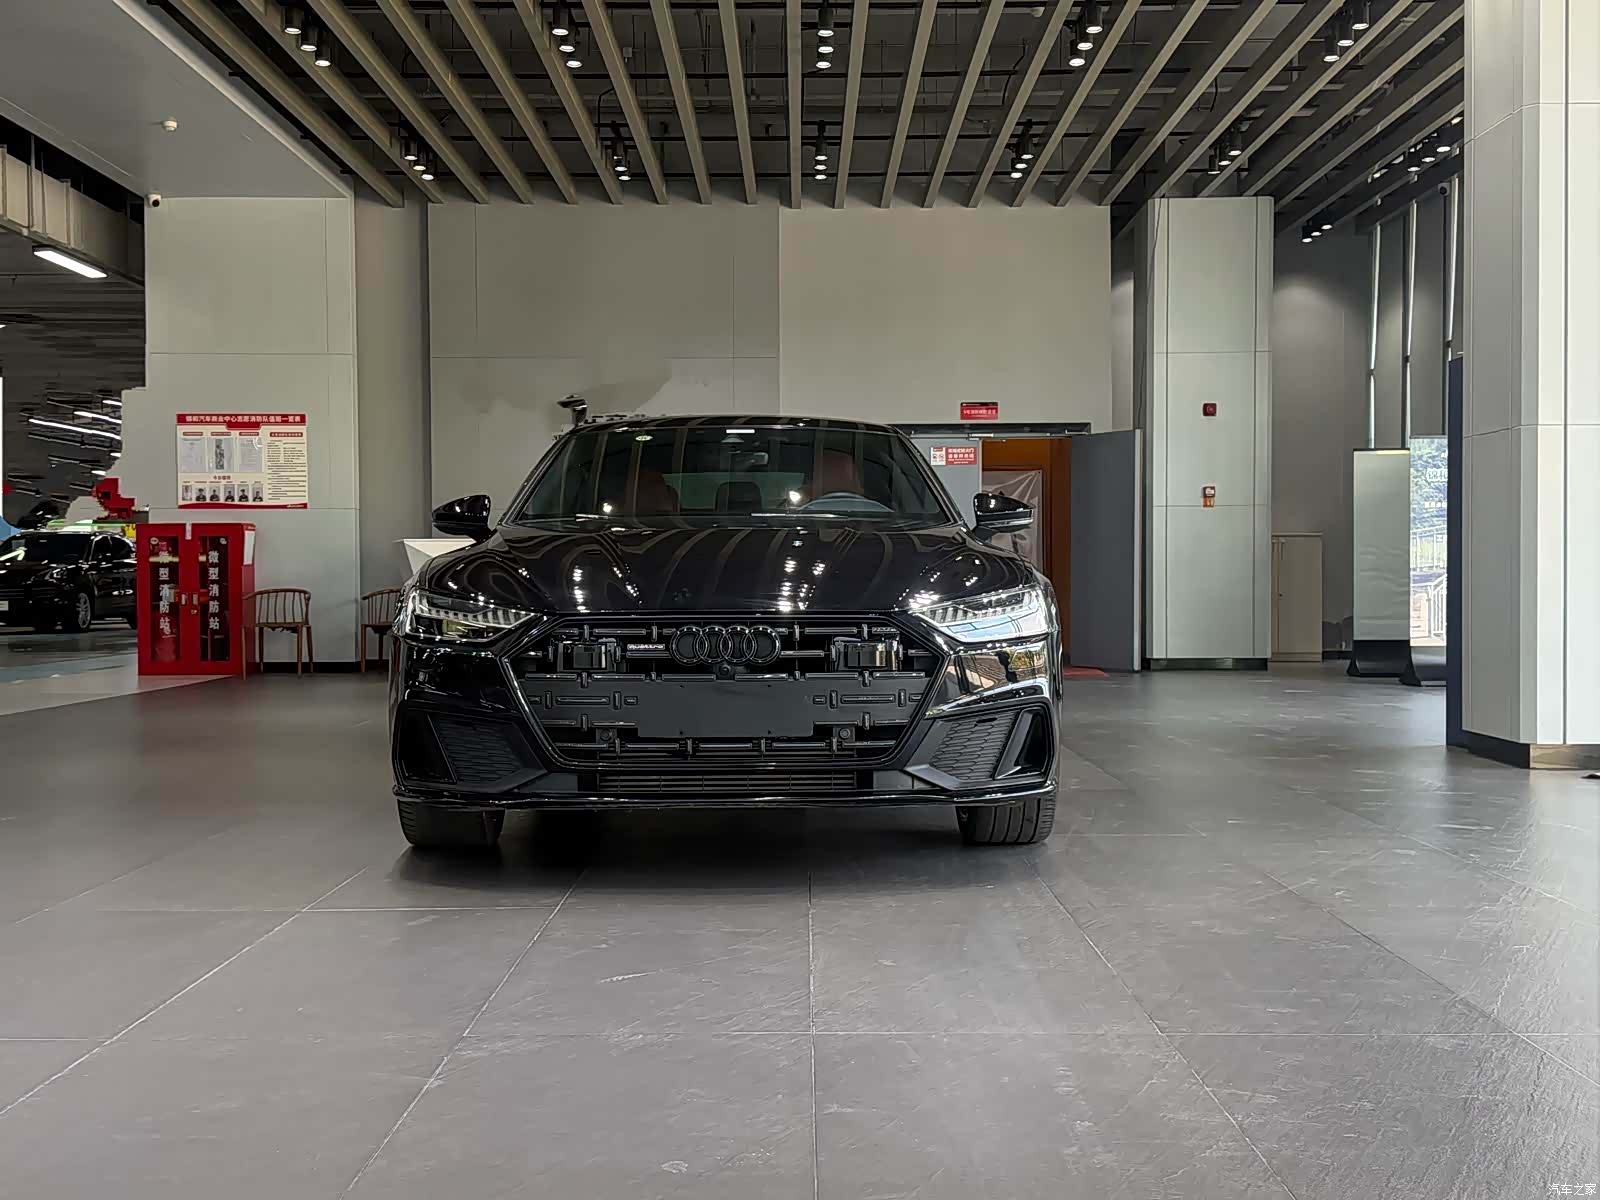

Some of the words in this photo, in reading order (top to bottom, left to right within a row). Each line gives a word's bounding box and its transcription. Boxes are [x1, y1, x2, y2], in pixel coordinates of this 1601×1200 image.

[208, 551, 220, 630] 微型消防站
